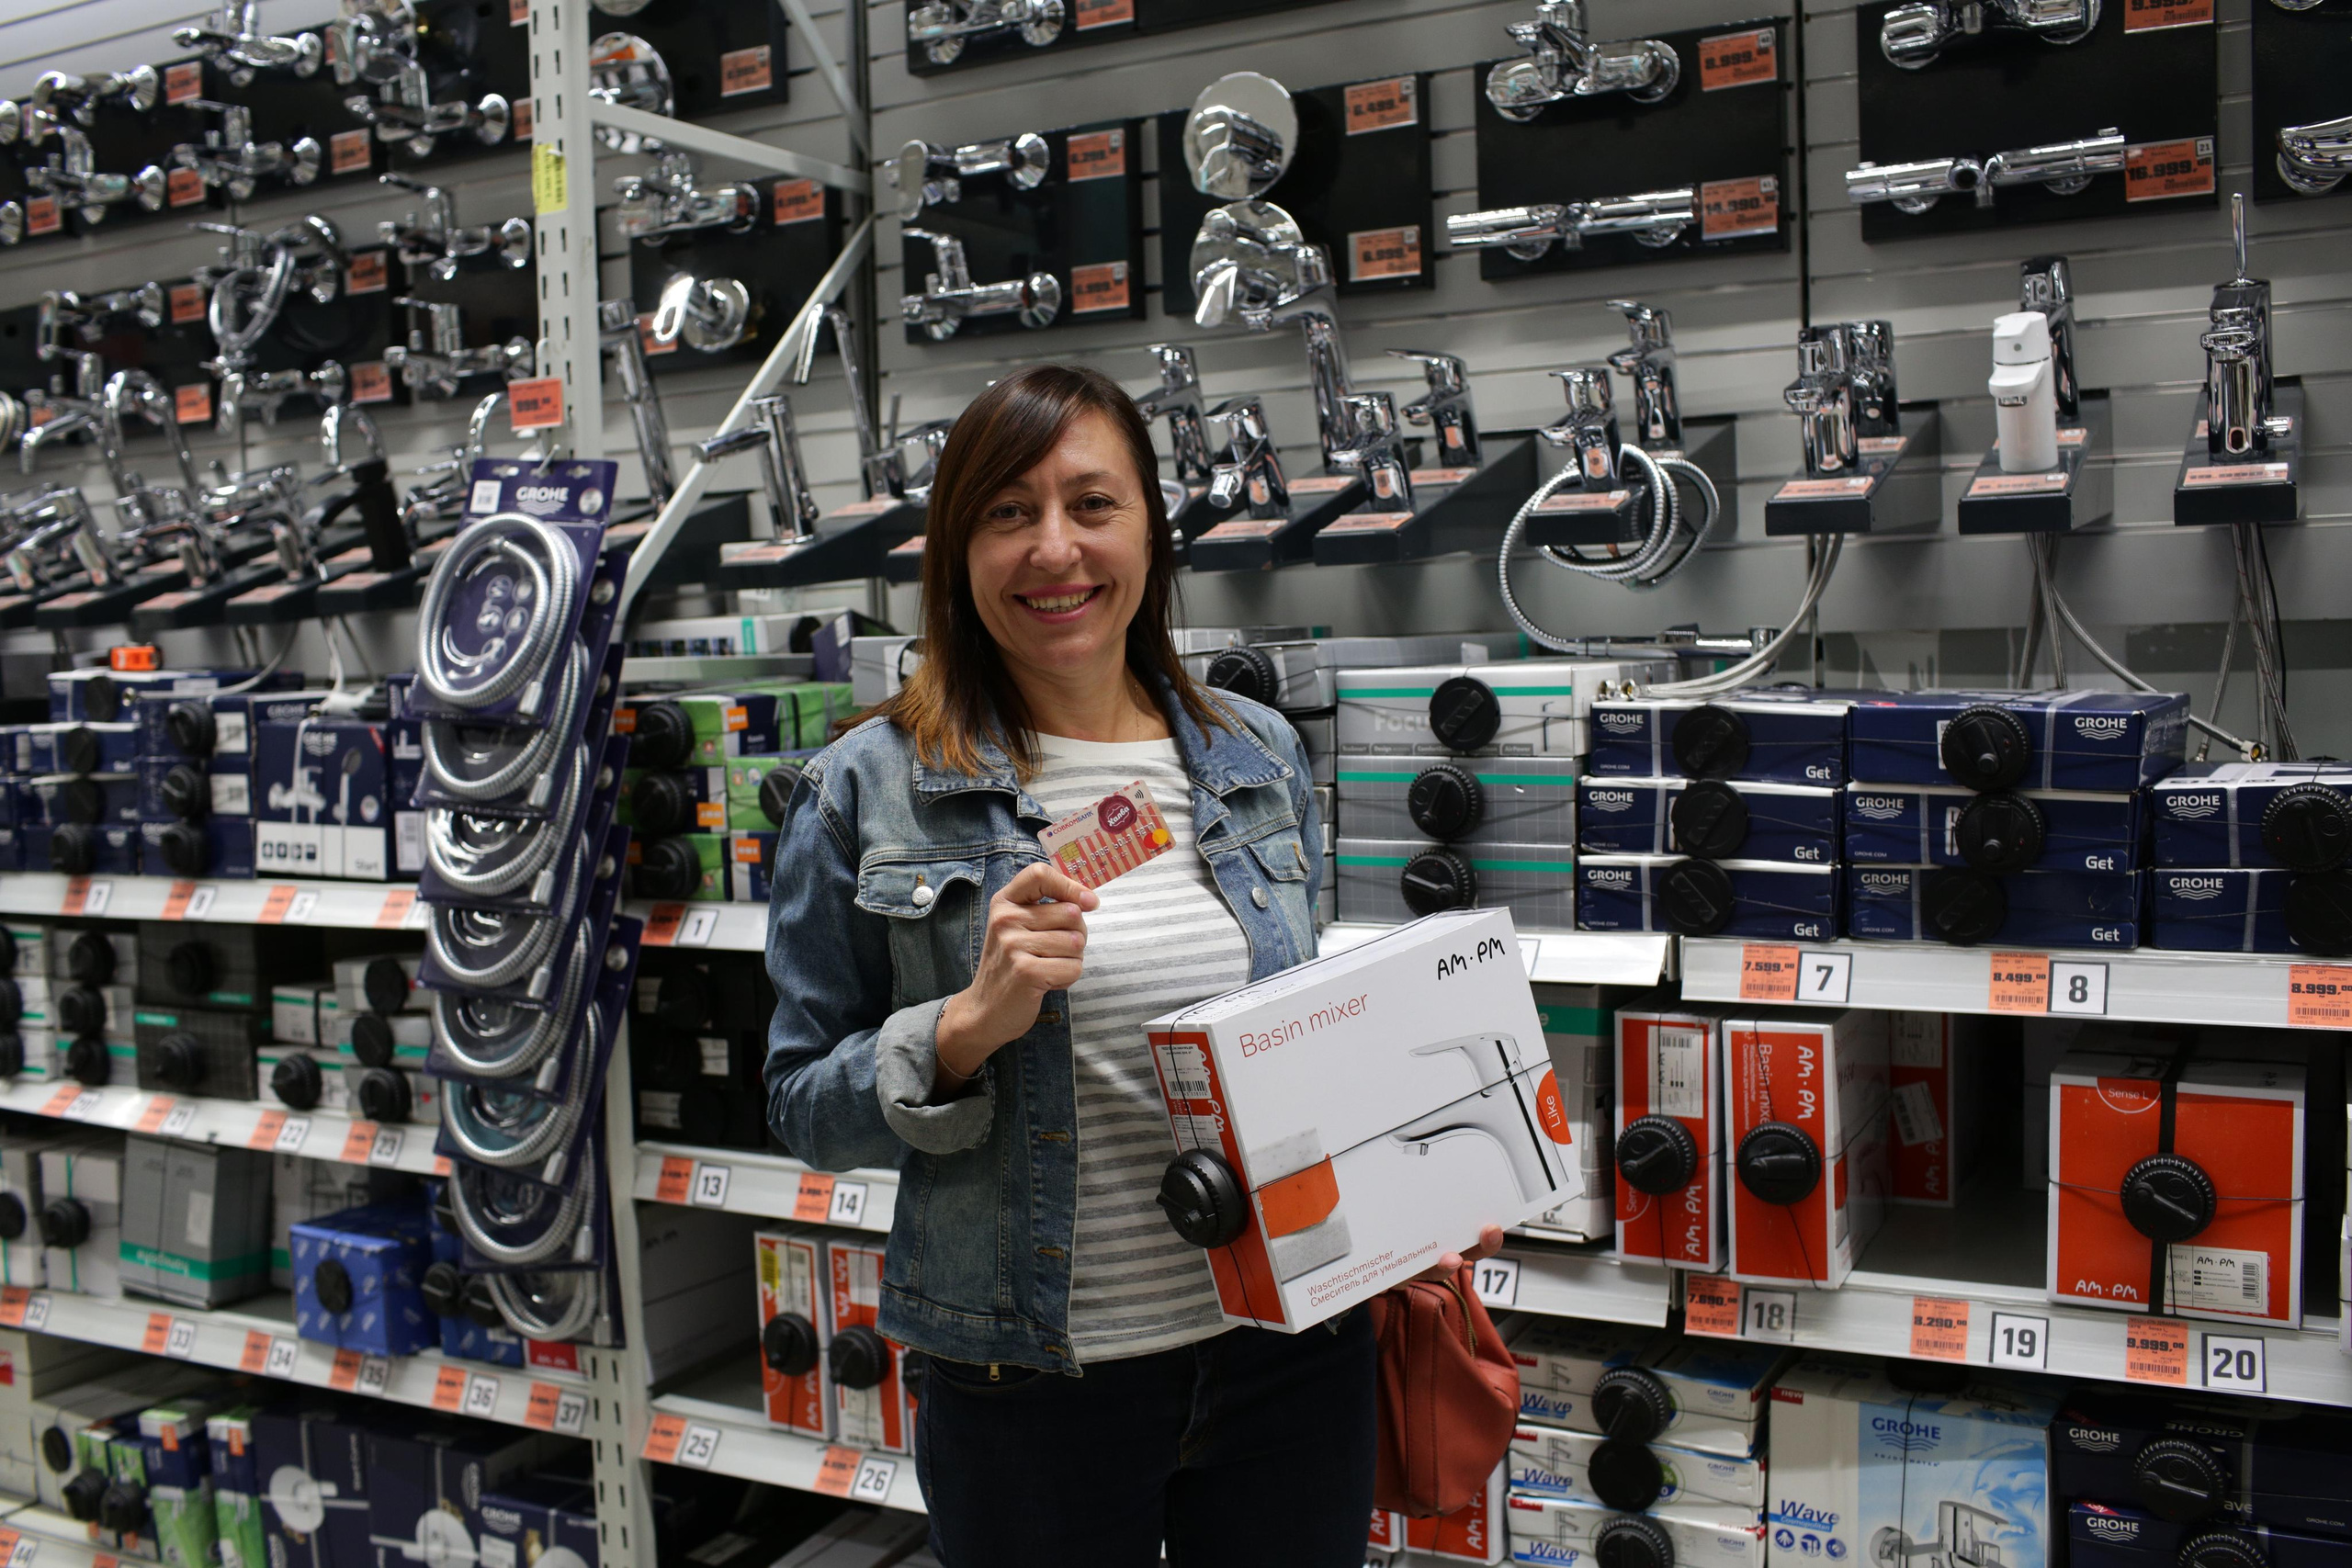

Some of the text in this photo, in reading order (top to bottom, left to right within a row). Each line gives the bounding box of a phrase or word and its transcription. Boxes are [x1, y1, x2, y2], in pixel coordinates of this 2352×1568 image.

[2199, 143, 2211, 152] 21
[516, 486, 569, 502] GROHE
[1374, 710, 1433, 732] Focu
[1600, 713, 1644, 725] GROHE
[2075, 716, 2128, 730] GROHE
[1805, 764, 1830, 780] Get
[1589, 791, 1634, 802] GROHE
[1855, 795, 1904, 809] GROHE
[2165, 795, 2221, 807] GROHE
[1052, 810, 1093, 835] СОВКОМБАНК
[1107, 806, 1130, 827] Халва
[1794, 846, 1820, 862] Get
[2086, 856, 2114, 871] Get
[1588, 869, 1633, 881] GROHE
[1860, 873, 1910, 886] GROHE
[2169, 877, 2223, 890] GROHE
[694, 918, 704, 938] 1
[1793, 923, 1819, 939] Get
[2092, 927, 2120, 942] Get
[1745, 961, 1795, 972] 7.599,00
[1815, 964, 1834, 991] 7
[1993, 972, 2046, 983] 8.499,00
[2068, 975, 2088, 1004] 8
[1238, 993, 1370, 1058] Basin mixer
[1758, 1043, 1773, 1125] Basin mixe
[2108, 1089, 2149, 1100] Sense L
[1545, 1094, 1562, 1129] Like
[282, 1123, 302, 1143] 22
[377, 1137, 396, 1156] 23
[702, 1176, 722, 1197] 13
[836, 1191, 857, 1215] 14
[1625, 1183, 1637, 1213] Sens
[1306, 1249, 1395, 1296] Waschtischmischer
[1310, 1240, 1439, 1307] Смеситель для умывальника
[1482, 1269, 1509, 1294] 17
[26, 1303, 44, 1322] 32
[1754, 1302, 1785, 1330] 18
[1914, 1315, 1968, 1329] 8.290,00
[172, 1327, 191, 1348] 33
[2003, 1327, 2037, 1358] 19
[2127, 1337, 2185, 1352] 9.999,00
[273, 1345, 292, 1366] 34
[2213, 1348, 2256, 1381] 20
[365, 1365, 384, 1385] 35
[470, 1385, 491, 1408] 36
[1522, 1392, 1573, 1414] Wave
[1707, 1389, 1736, 1399] GROHE
[560, 1400, 581, 1424] 37
[1871, 1416, 1941, 1440] GROHE
[2069, 1427, 2120, 1443] GROHE
[686, 1435, 711, 1459] 25
[1708, 1461, 1736, 1472] GROHE
[862, 1468, 886, 1492] 26
[1523, 1467, 1574, 1487] Wave
[481, 1506, 522, 1524] GROHE
[1781, 1499, 1840, 1525] Wave
[2223, 1500, 2253, 1514] ave
[1780, 1516, 1831, 1531] Cosmopolitan
[2086, 1517, 2140, 1533] GROHE
[2306, 1517, 2346, 1528] GROHE.COM
[1529, 1540, 1579, 1561] Wave
[1717, 1536, 1746, 1547] GROHE
[13, 1544, 33, 1563] 44
